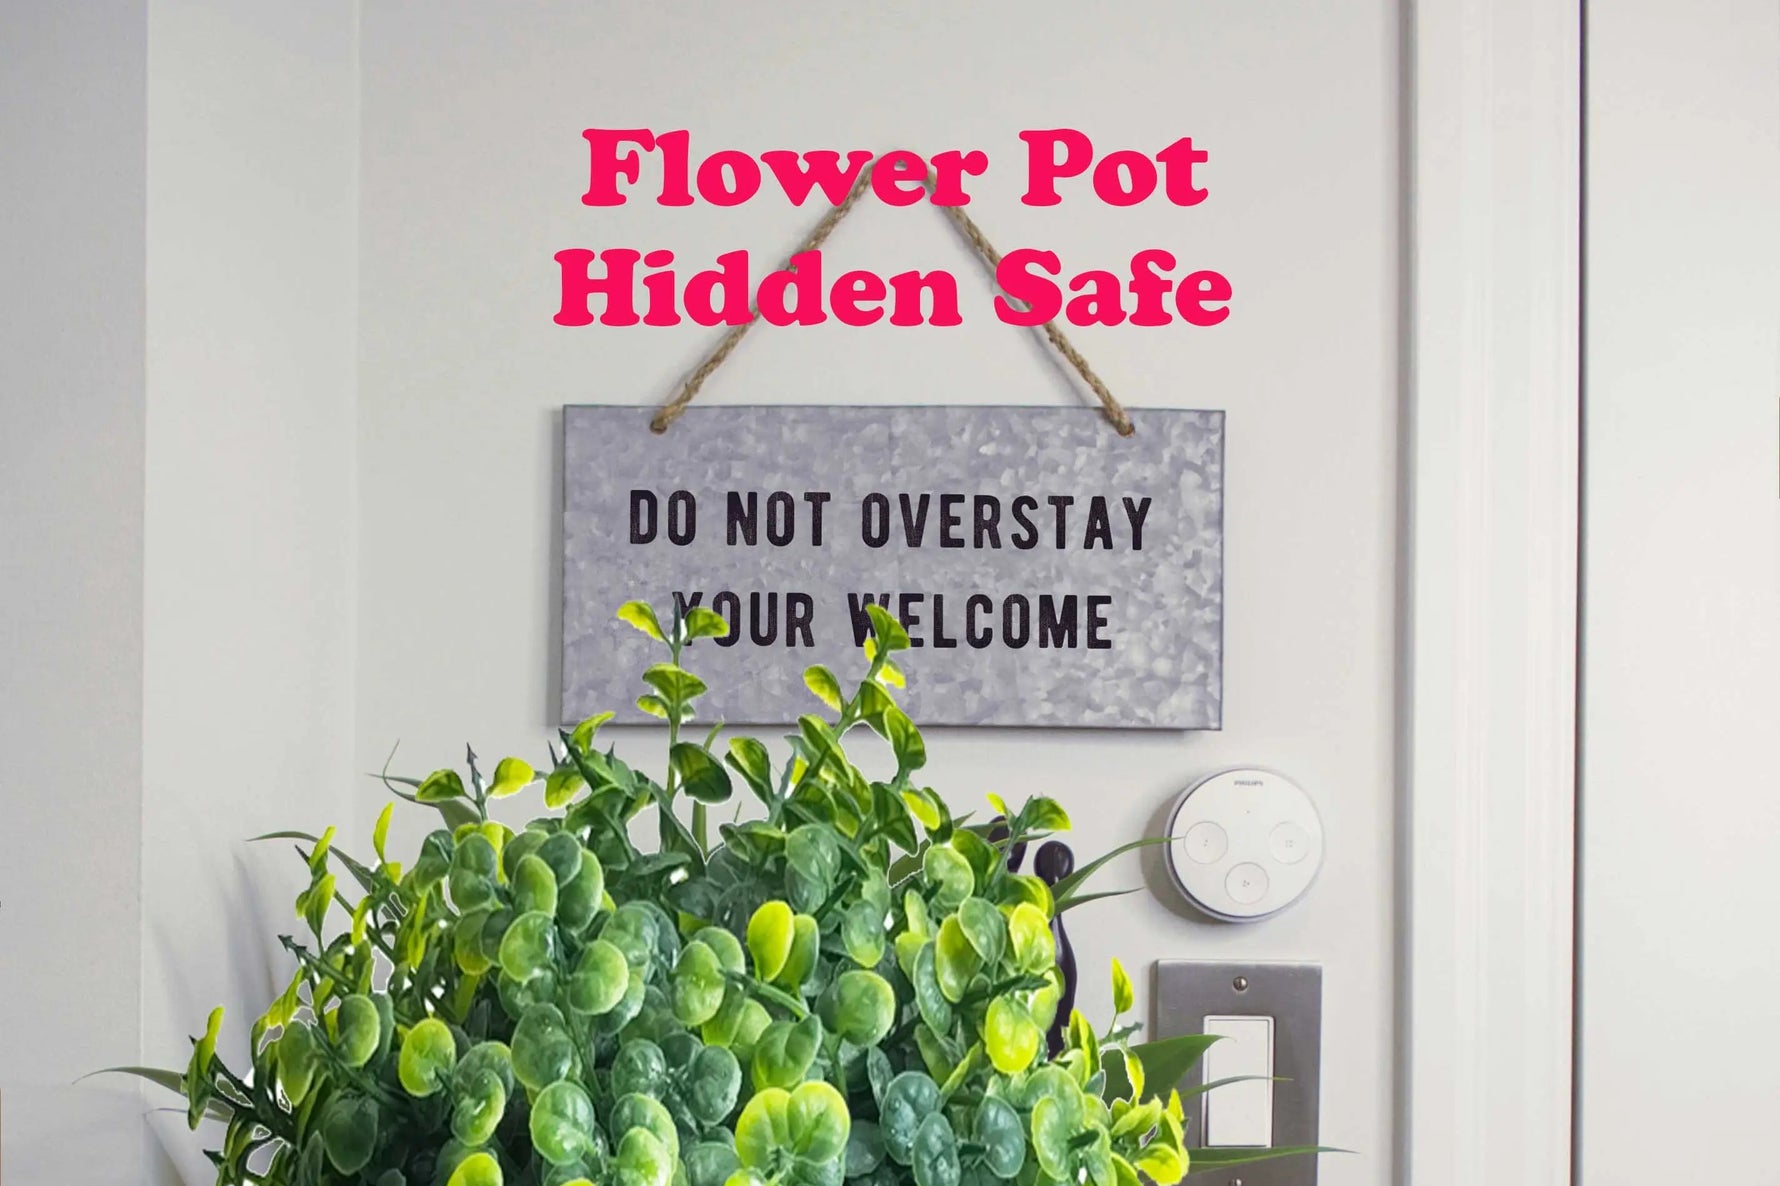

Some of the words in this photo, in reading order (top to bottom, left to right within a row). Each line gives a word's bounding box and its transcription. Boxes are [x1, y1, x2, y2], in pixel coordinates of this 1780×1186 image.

[629, 489, 697, 547] DO
[726, 490, 831, 547] NOT
[861, 492, 1152, 551] OVERSTAY
[847, 592, 1112, 650] WELCOME
